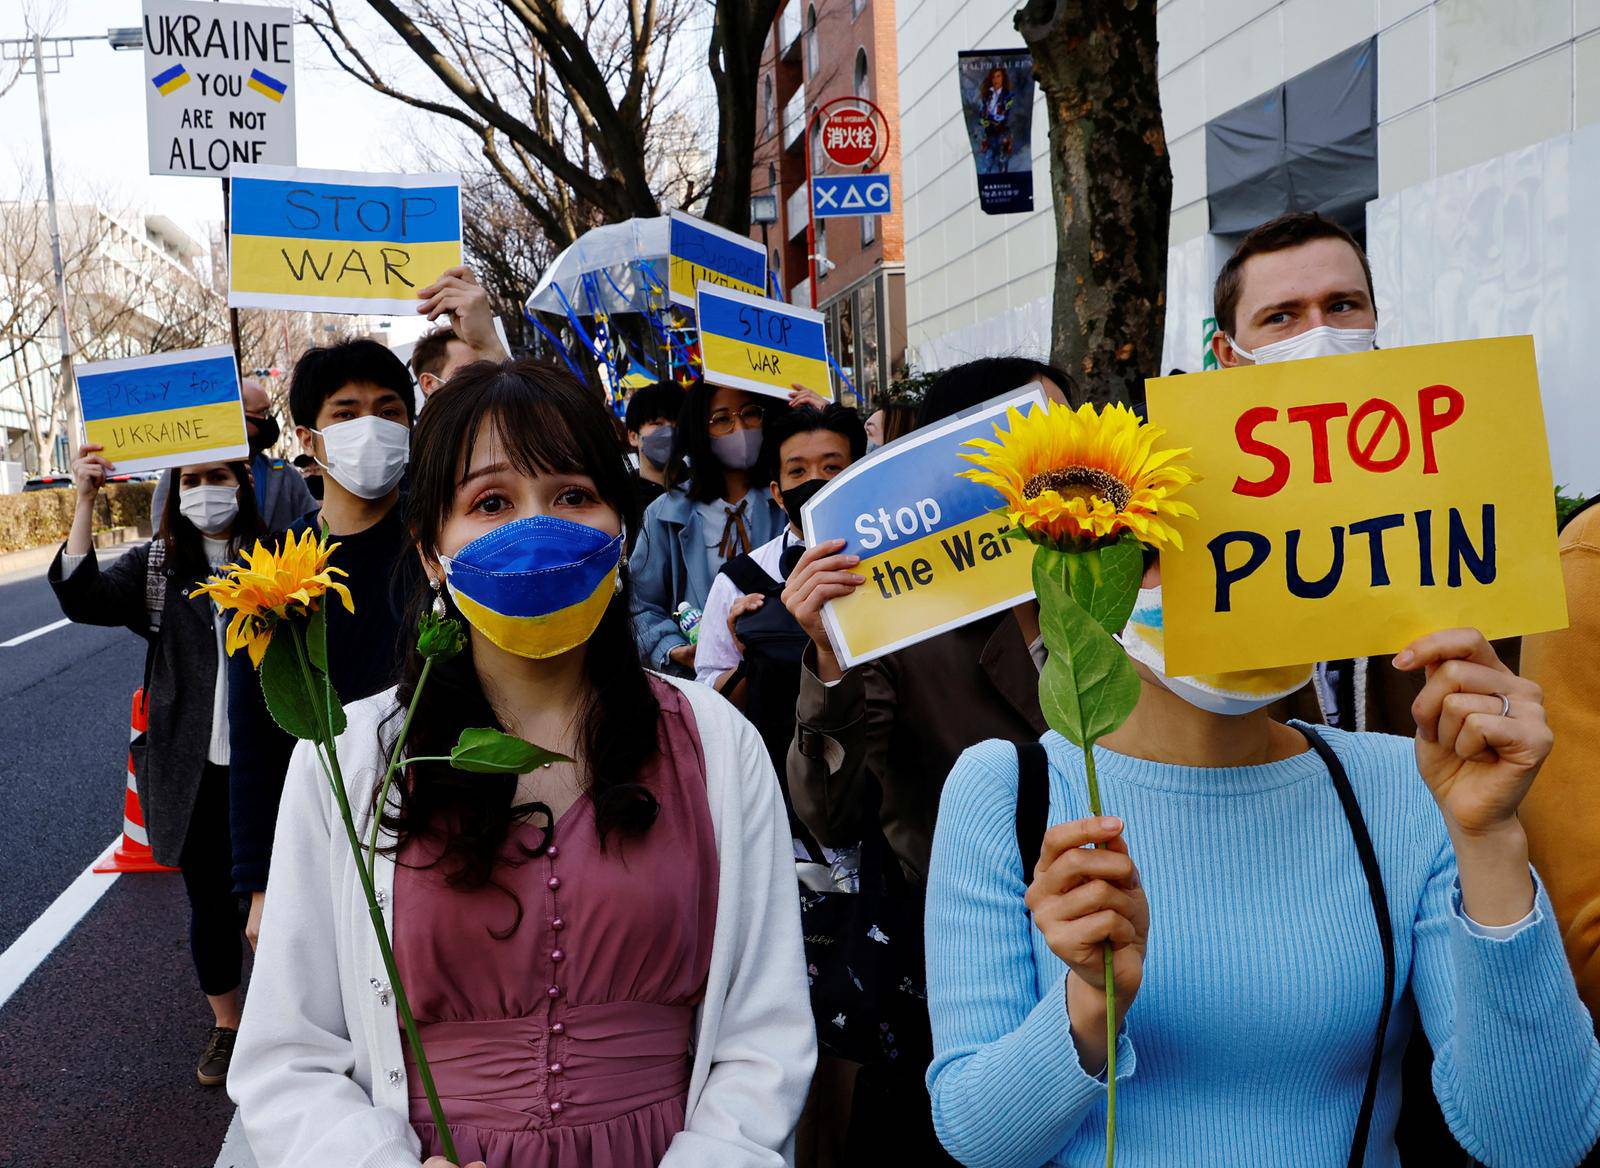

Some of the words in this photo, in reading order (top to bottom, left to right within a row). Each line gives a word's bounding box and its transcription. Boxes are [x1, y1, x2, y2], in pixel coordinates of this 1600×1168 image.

[144, 14, 291, 64] UKRAINE
[197, 72, 242, 97] YOU
[181, 108, 213, 129] ARE
[229, 111, 266, 131] NOT
[826, 126, 874, 150] 消火栓
[286, 188, 438, 238] STOP
[281, 247, 416, 288] WAR
[738, 306, 792, 347] STOP
[746, 347, 782, 376] WAR
[112, 418, 209, 449] UKRAINE
[1232, 384, 1465, 498] STOP
[854, 496, 942, 550] Stop
[872, 557, 934, 600] the
[939, 524, 1013, 573] War
[1206, 503, 1497, 613] PUTIN
